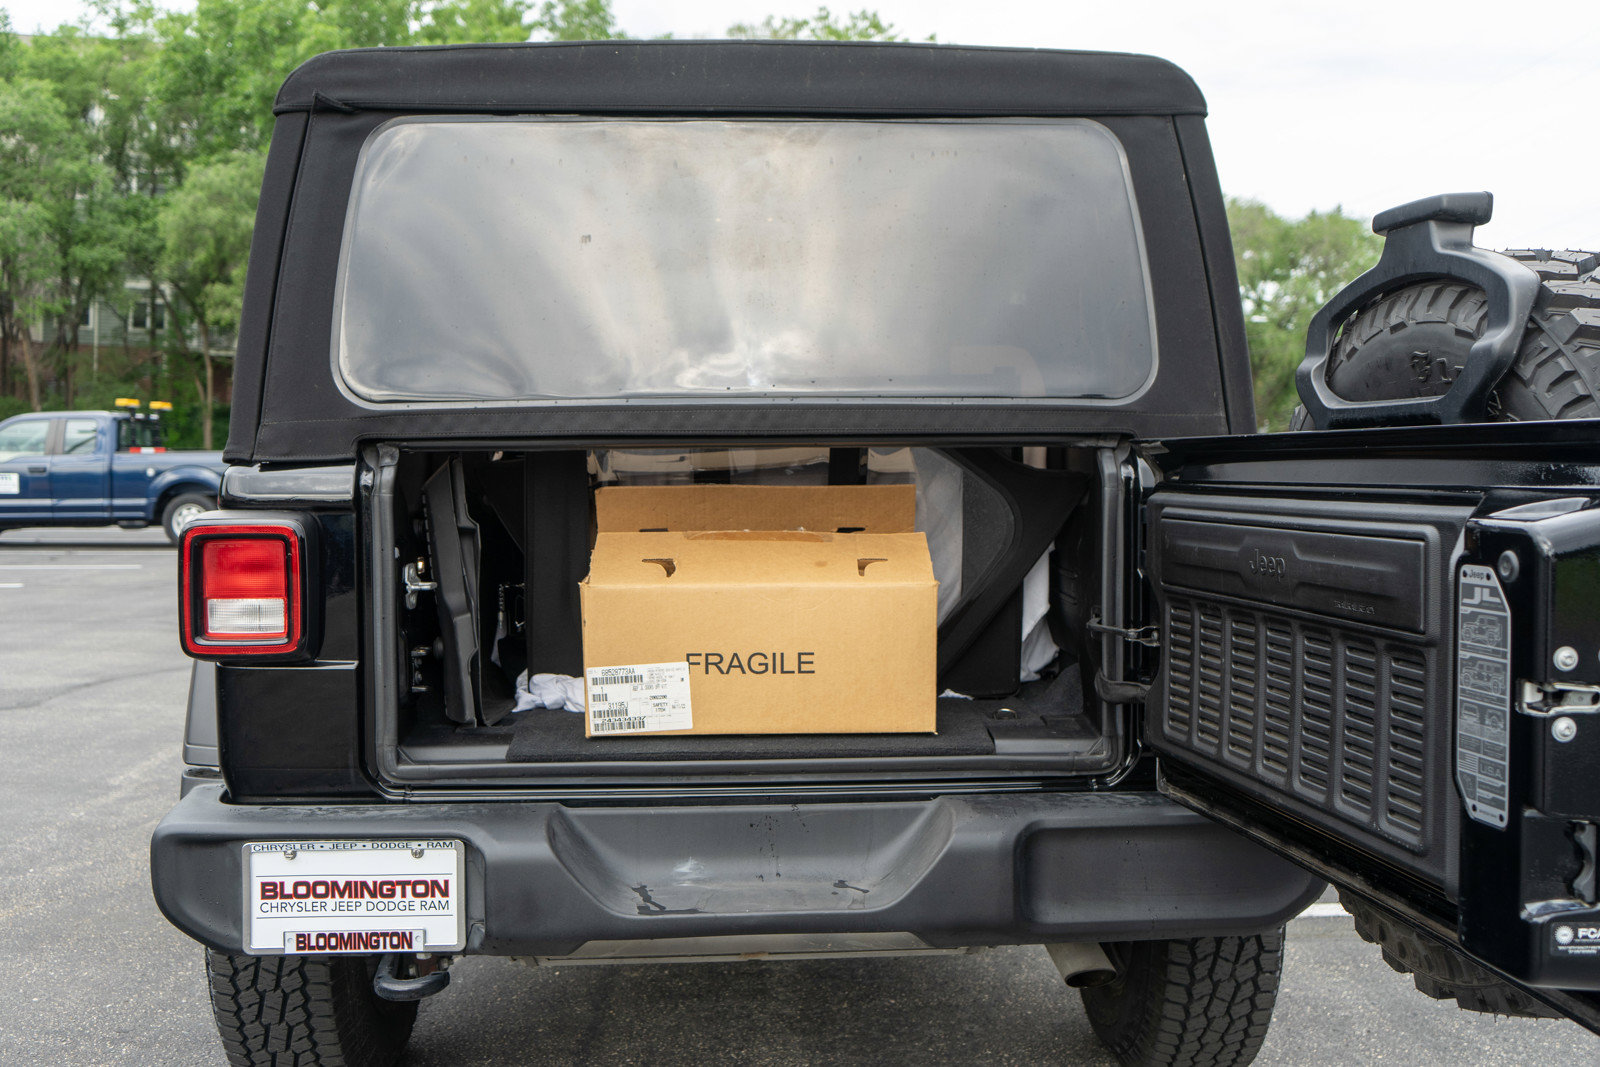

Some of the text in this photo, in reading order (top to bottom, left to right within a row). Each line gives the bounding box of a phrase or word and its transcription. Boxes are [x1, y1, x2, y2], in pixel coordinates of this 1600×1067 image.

[1249, 548, 1286, 582] Jeep
[1469, 569, 1485, 580] Jeep
[1462, 587, 1502, 604] JL
[686, 651, 815, 674] FRAGILE
[252, 843, 315, 851] CHRYSLER
[371, 841, 413, 849] DODGE
[259, 879, 450, 900] BLOOMINGTON
[259, 900, 450, 913] CHRYSLER JEEP DODGE RAM
[295, 931, 413, 951] BLOOMINGTON
